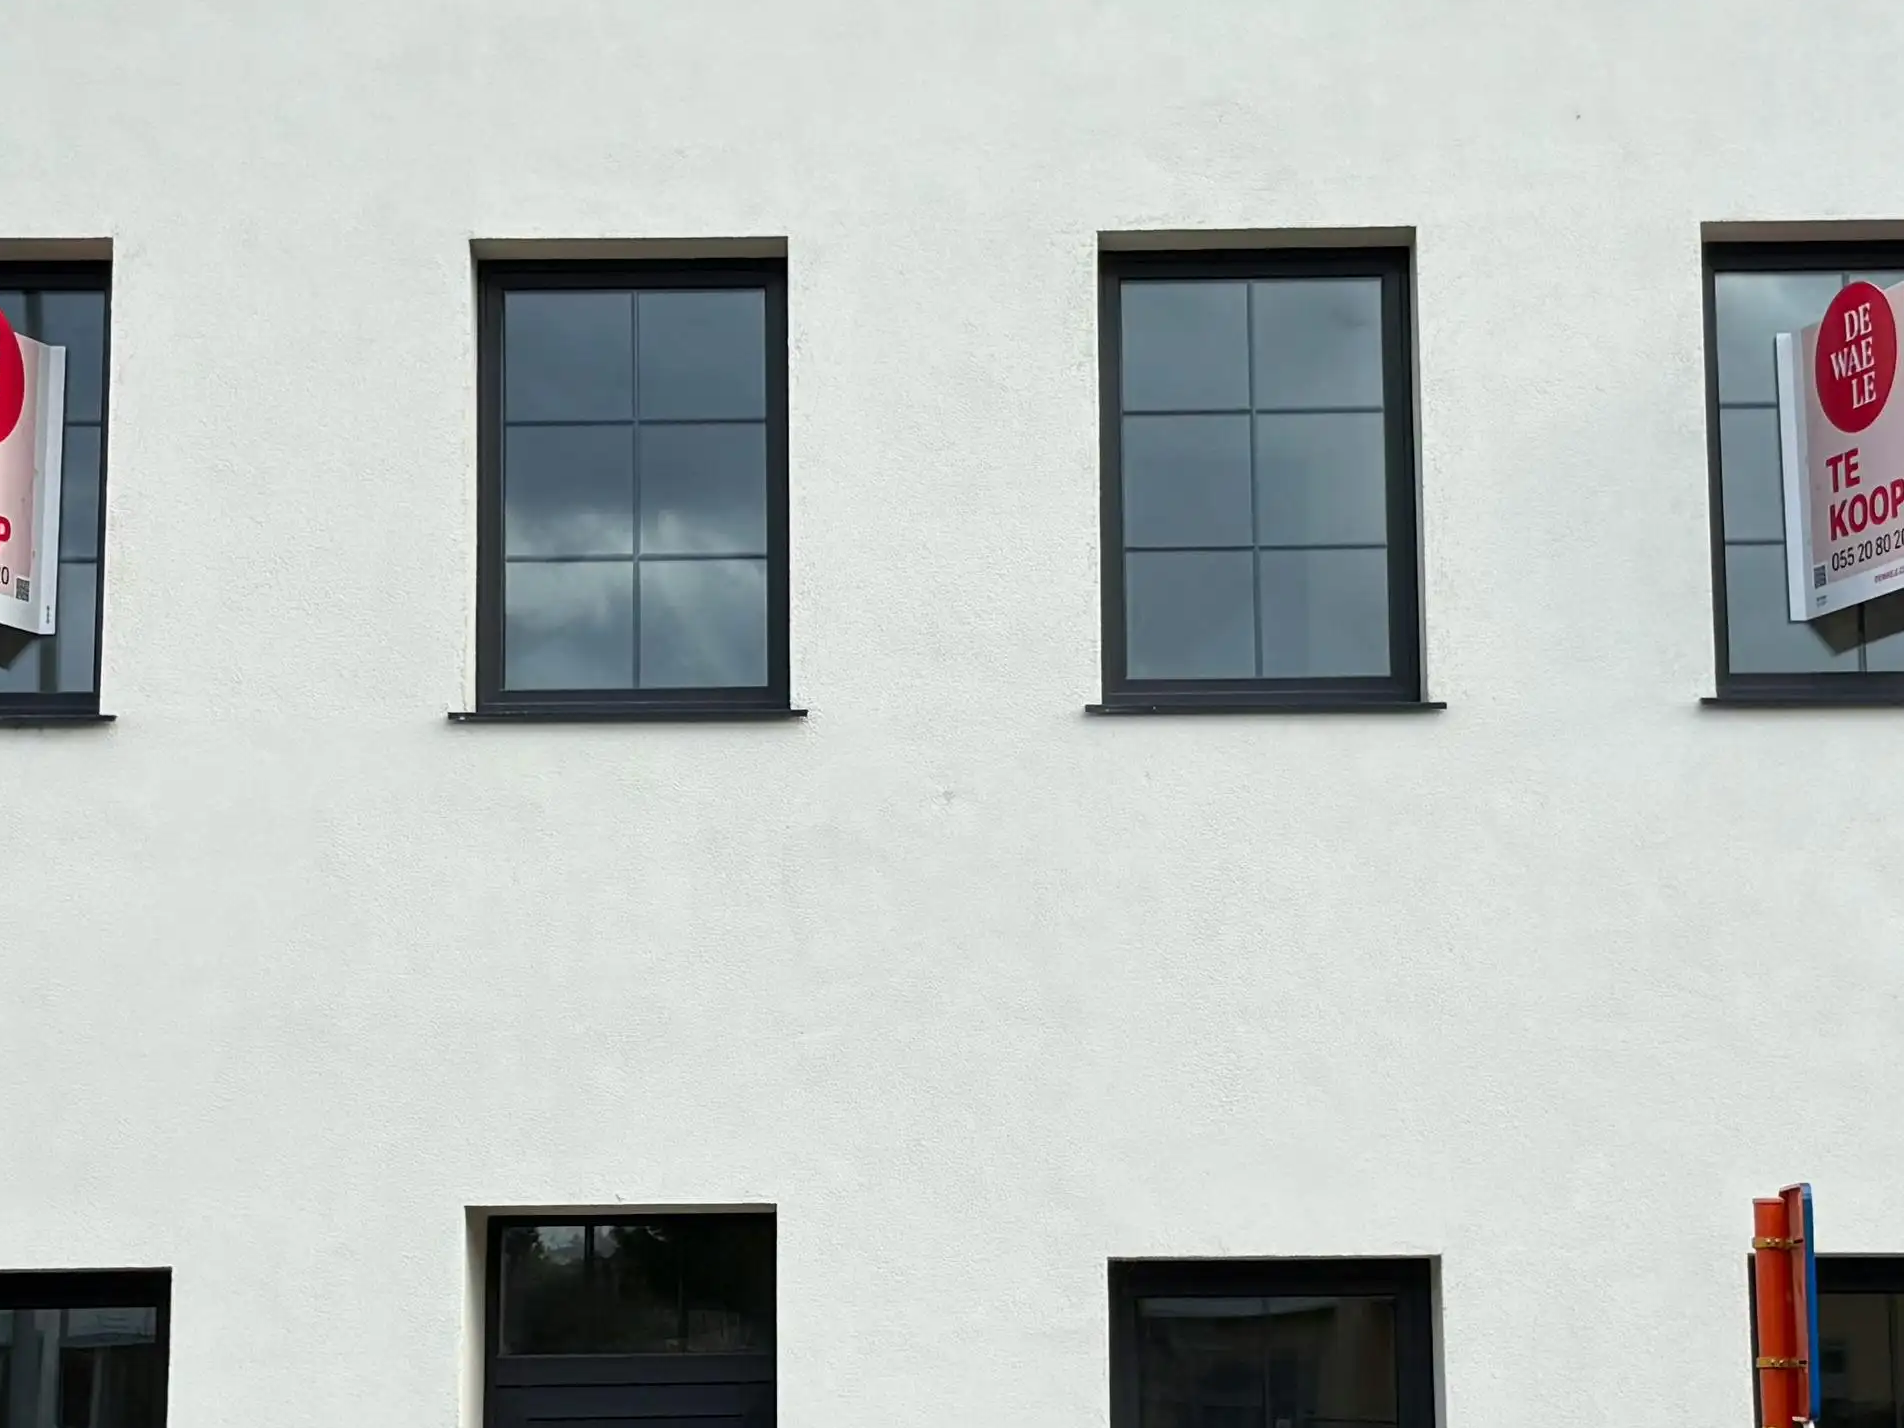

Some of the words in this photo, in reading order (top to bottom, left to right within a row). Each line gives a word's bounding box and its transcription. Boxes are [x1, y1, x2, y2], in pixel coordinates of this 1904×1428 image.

[1843, 302, 1872, 342] DE
[1830, 336, 1875, 381] WAE
[1851, 371, 1876, 409] LE
[1825, 447, 1860, 493] TE
[1831, 546, 1855, 571] 055
[1857, 539, 1873, 563] 20
[1875, 533, 1892, 556] 80
